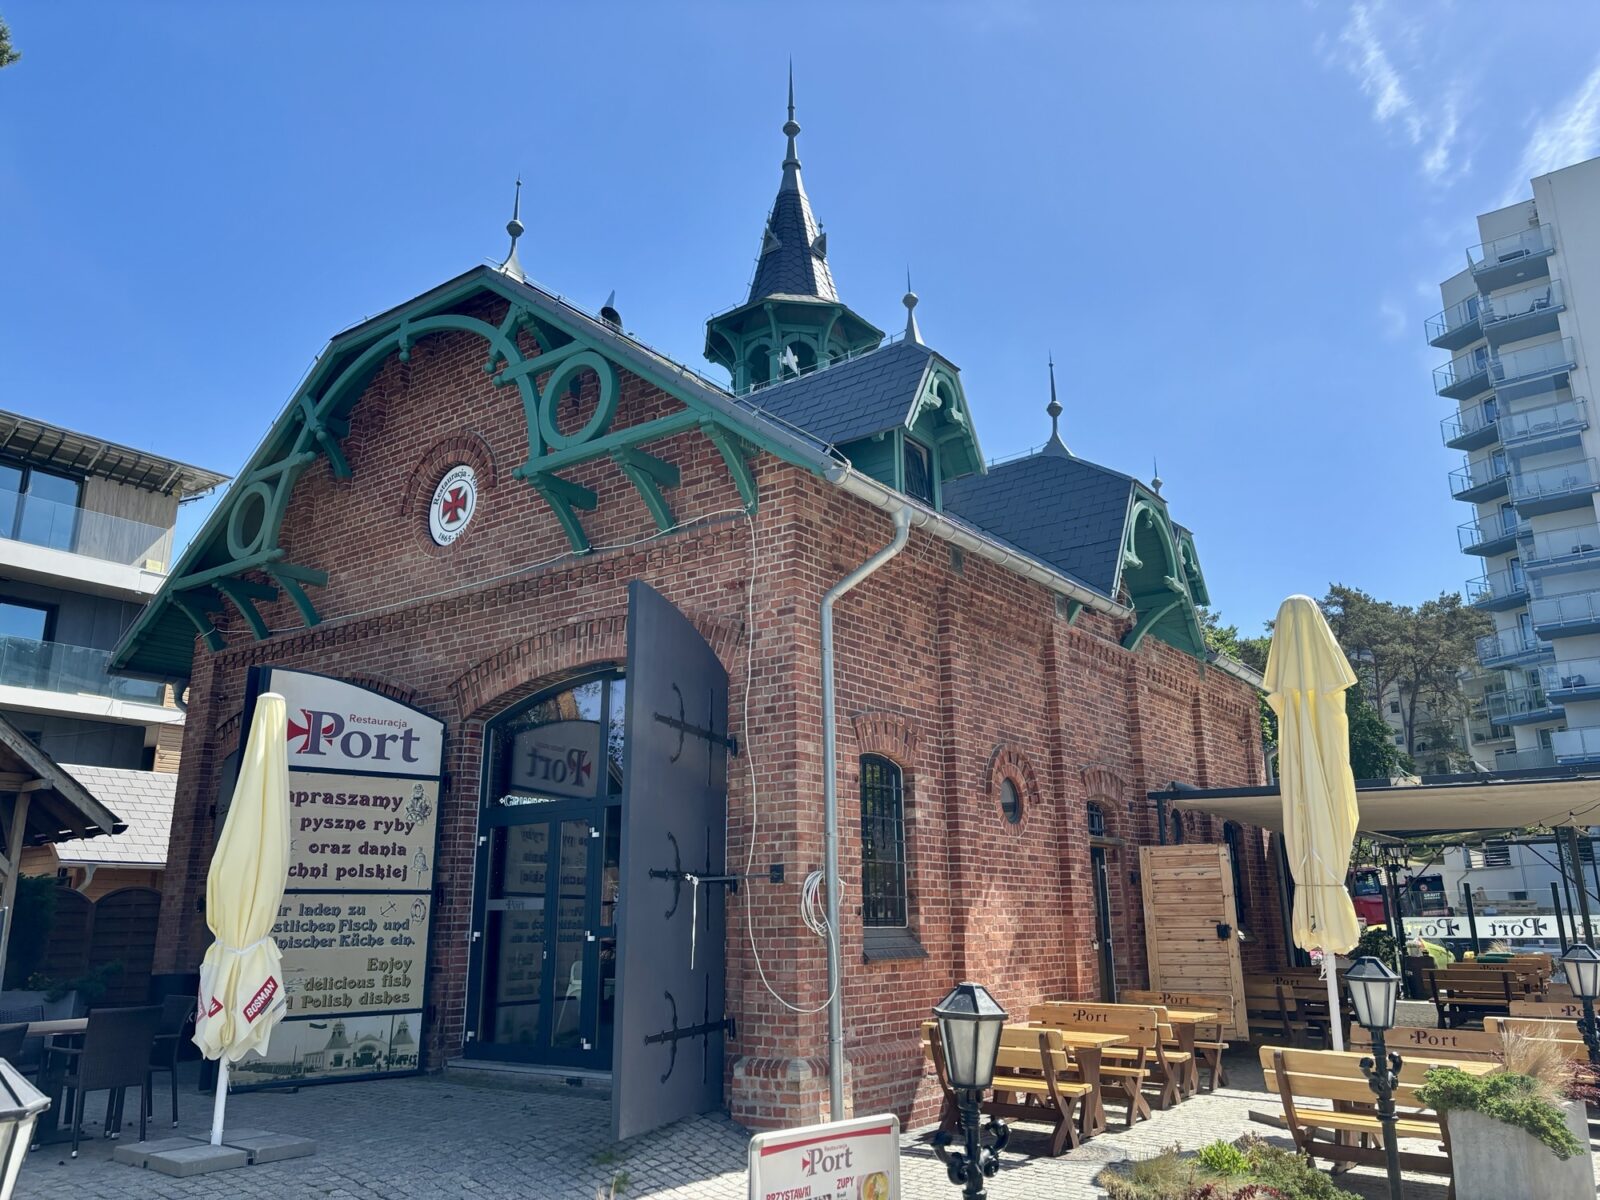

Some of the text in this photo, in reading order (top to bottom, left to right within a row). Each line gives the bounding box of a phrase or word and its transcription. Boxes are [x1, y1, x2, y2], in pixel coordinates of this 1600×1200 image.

[433, 470, 467, 505] Restauracja
[349, 713, 408, 729] Restauracja
[302, 710, 420, 763] Port
[289, 790, 403, 812] praszamy
[300, 816, 415, 835] pyszne ryby
[308, 841, 407, 857] oraz dania
[288, 863, 408, 882] chni polskiej
[277, 902, 366, 918] ir laden zu
[271, 918, 410, 934] stlichen Fisch und
[273, 933, 415, 950] lnischer Küche ein.
[367, 957, 413, 974] Enjoy
[303, 974, 411, 991] delicious fish
[245, 980, 275, 1018] BOSMAN
[301, 994, 352, 1008] Polish
[358, 991, 410, 1005] dishes
[1163, 992, 1189, 1005] Port
[1077, 1008, 1108, 1023] Port
[1415, 1030, 1458, 1046] Port
[808, 1146, 853, 1176] Port
[836, 1176, 855, 1190] ZUPY
[765, 1185, 812, 1200] PRZYSTAWKI
